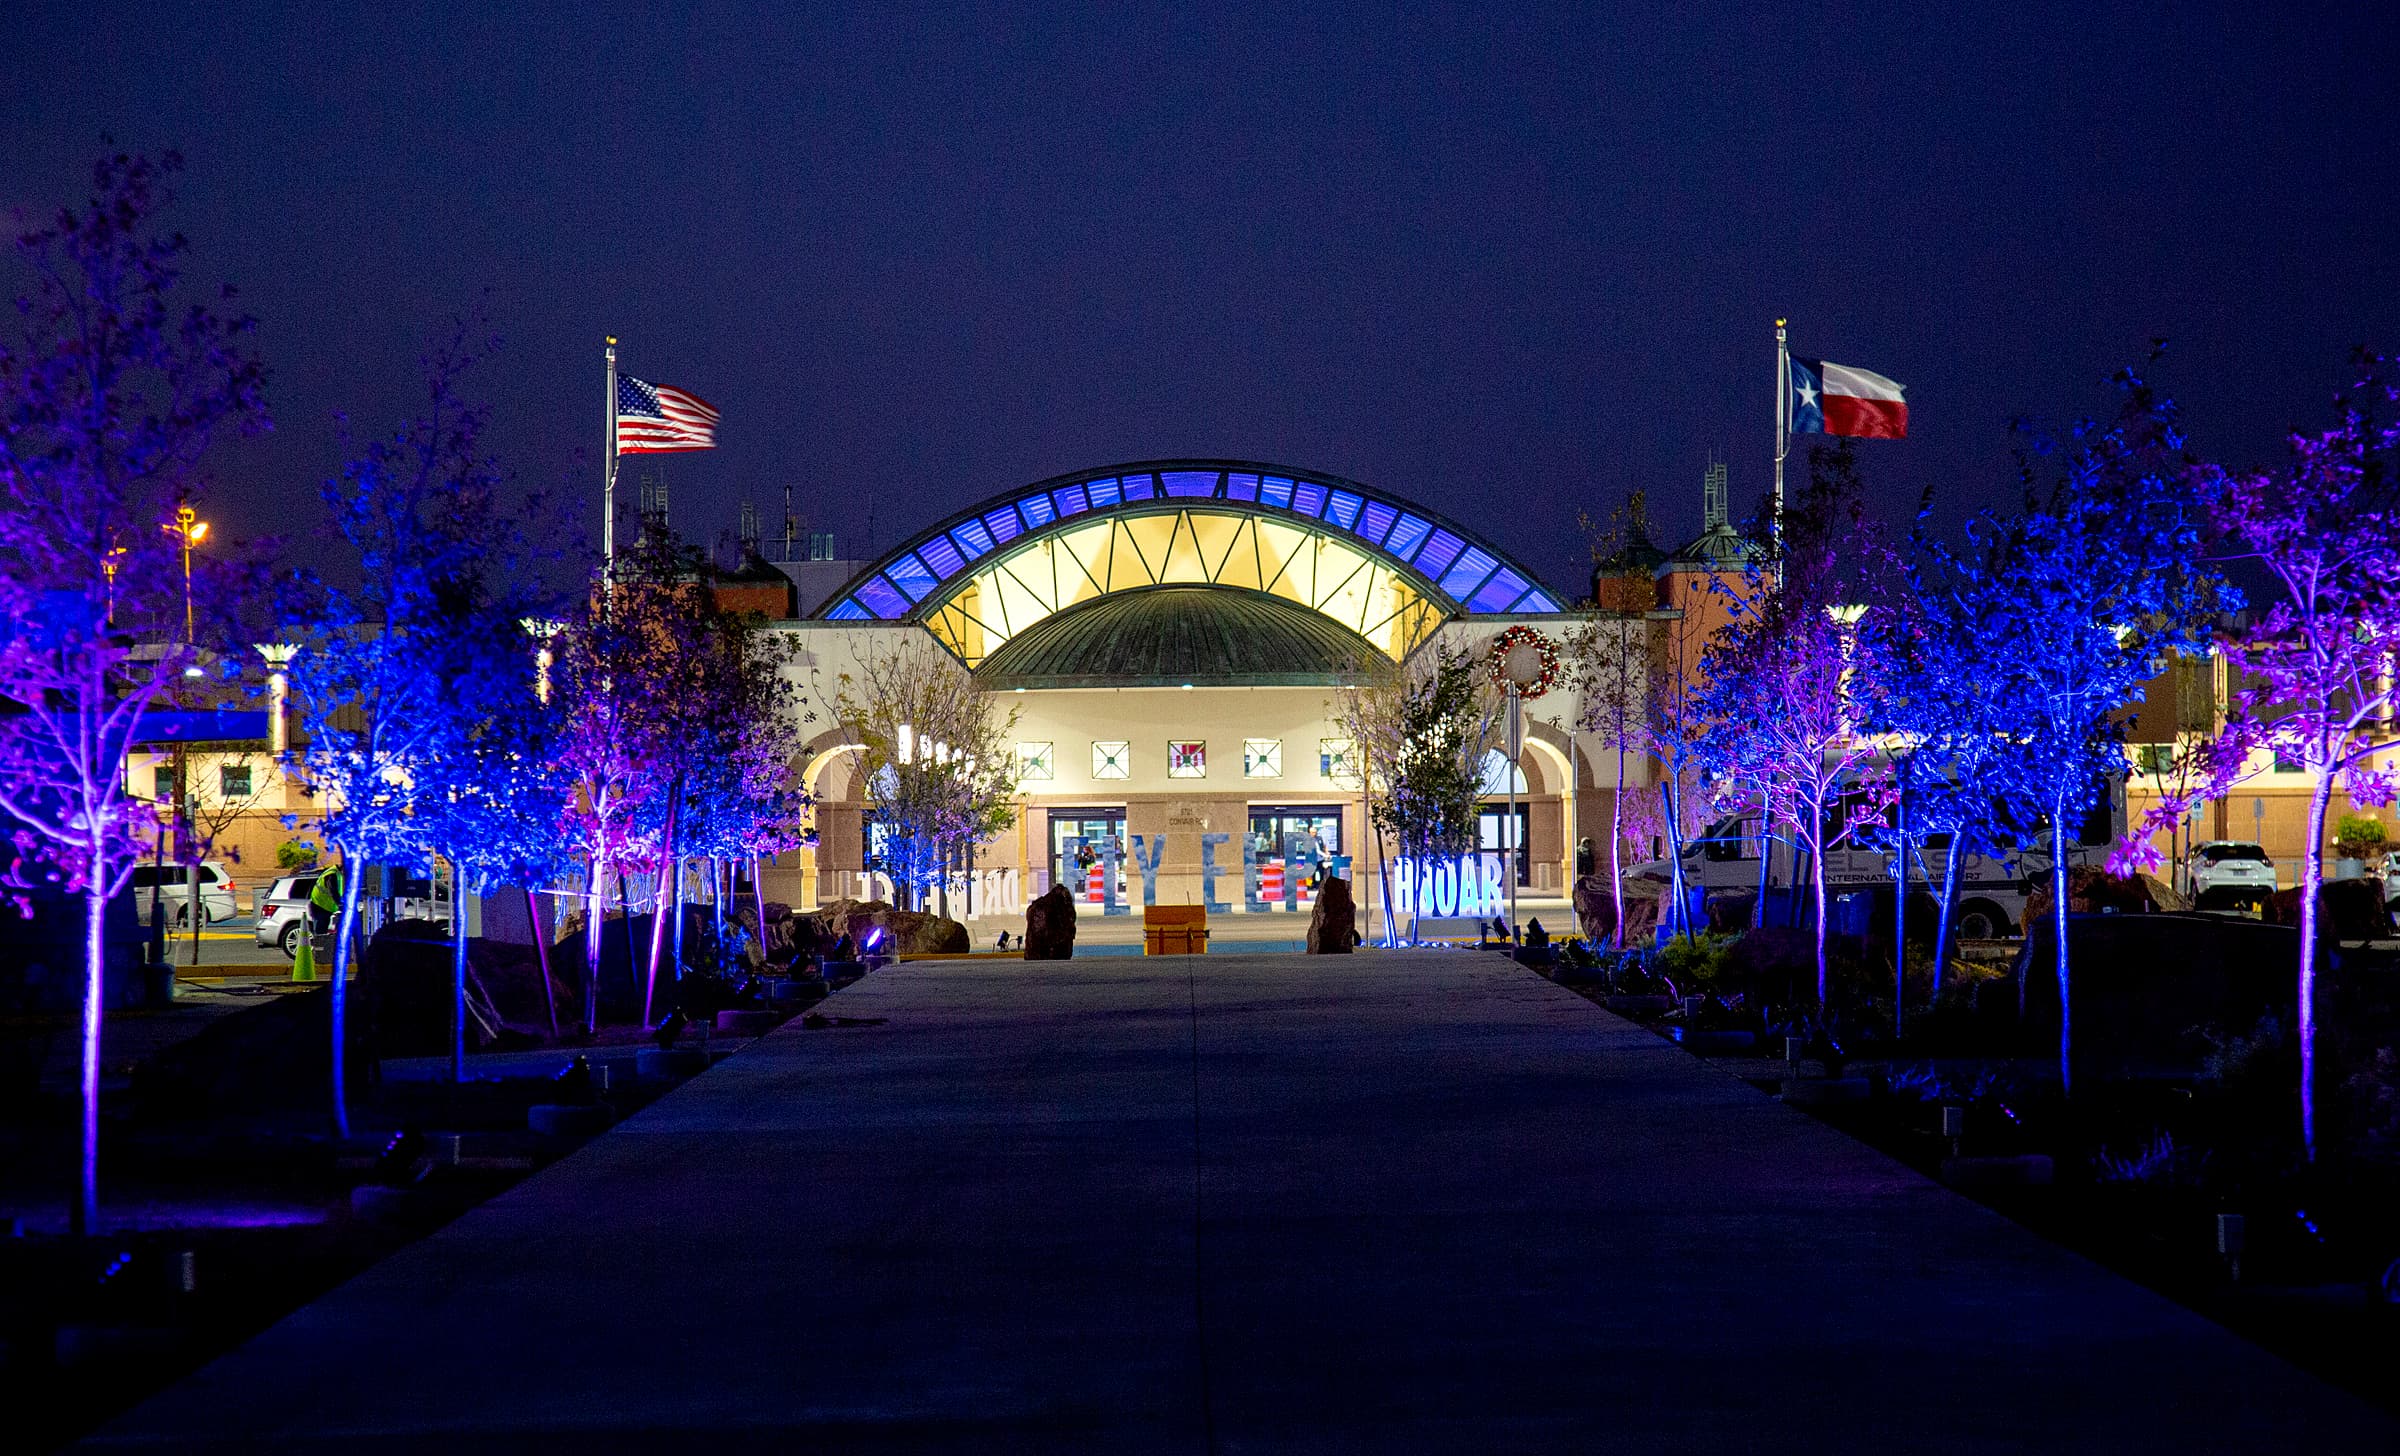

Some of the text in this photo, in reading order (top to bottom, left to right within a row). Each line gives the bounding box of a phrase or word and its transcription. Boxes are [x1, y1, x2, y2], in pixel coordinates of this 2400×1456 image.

[1824, 852, 1869, 872] EL
[1062, 834, 1167, 917] FLY
[1201, 831, 1317, 914] ELP
[1824, 872, 1983, 883] INTERNATIOAL AIRRT
